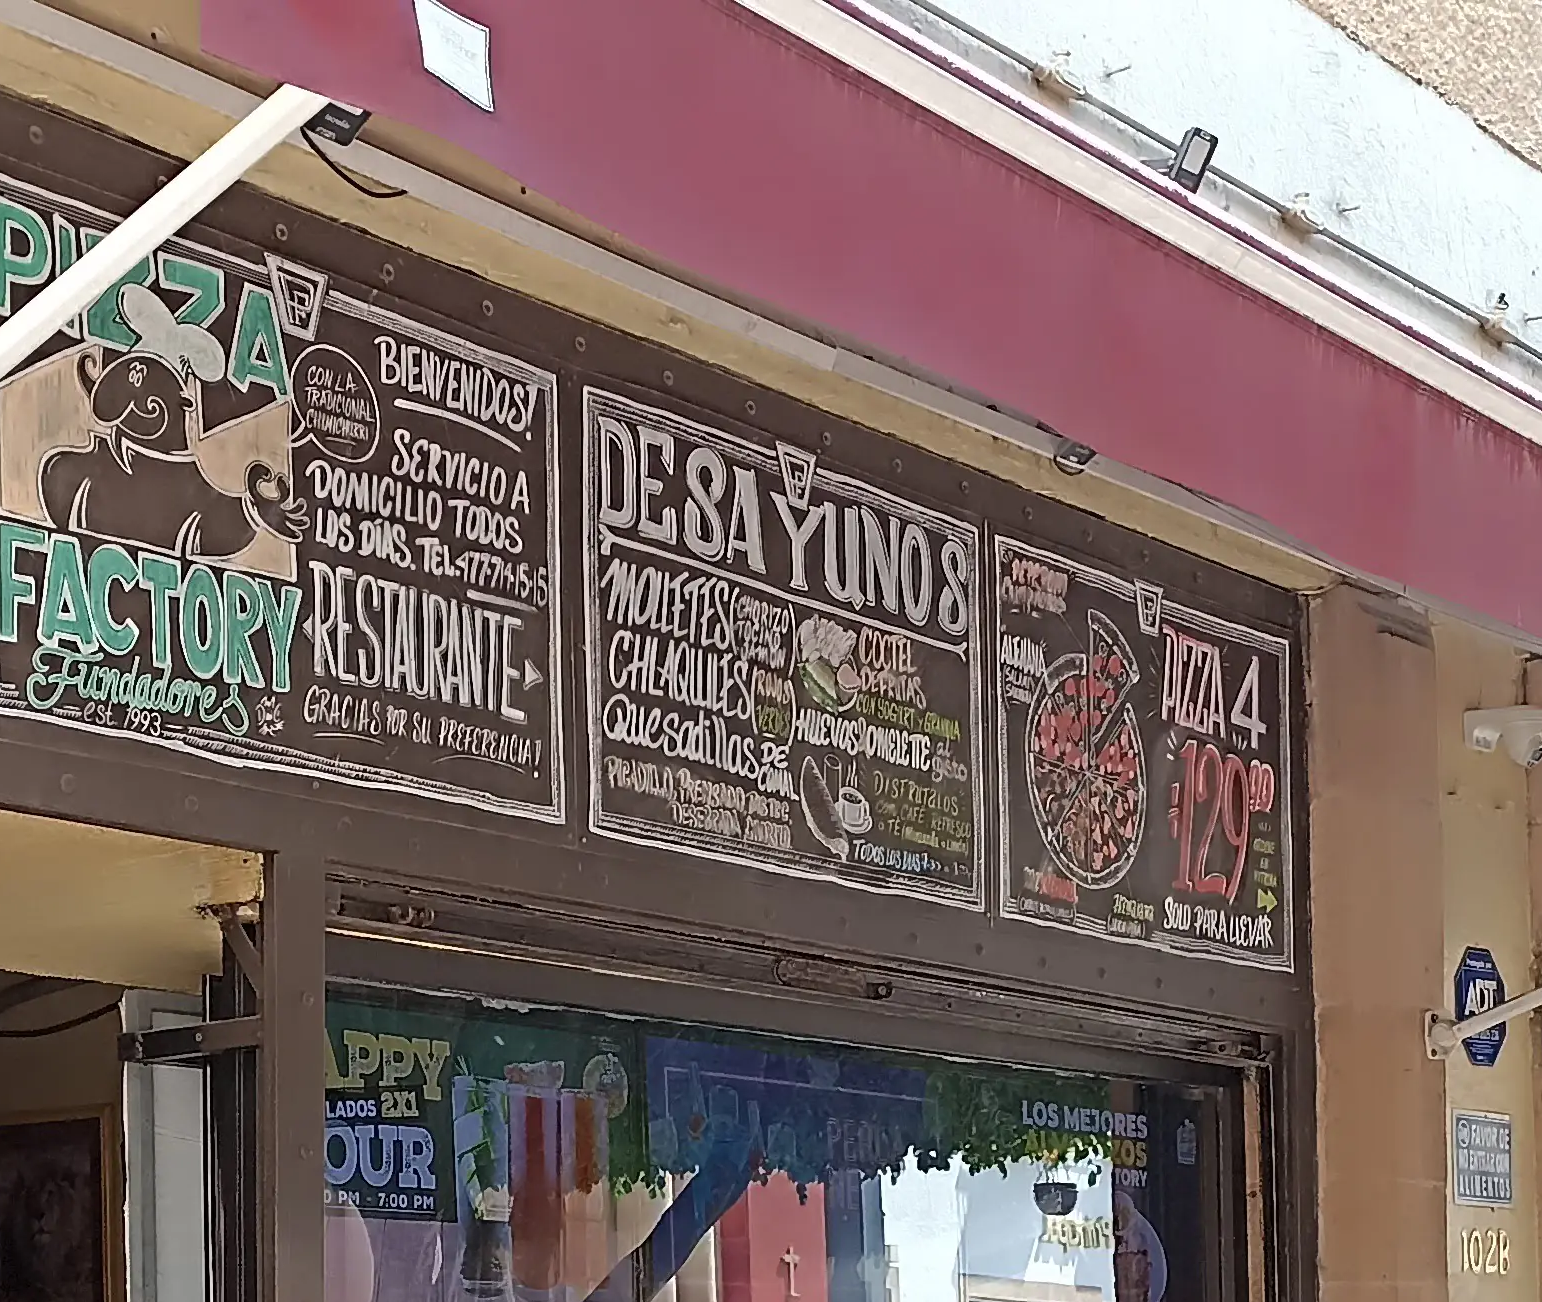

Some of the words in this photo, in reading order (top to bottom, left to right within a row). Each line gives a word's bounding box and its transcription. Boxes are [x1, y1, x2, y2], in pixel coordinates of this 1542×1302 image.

[307, 365, 335, 391] CON
[335, 371, 360, 395] LA
[373, 335, 541, 441] BIENVENIDOS!
[304, 386, 376, 425] TRADICIONAL
[391, 427, 507, 506] SERVICIO
[510, 470, 531, 515] A
[305, 459, 443, 532] DOMICILIO
[448, 498, 524, 555] TODOS
[315, 506, 356, 553] LOS
[597, 415, 970, 637] DESAYUNOS
[600, 557, 731, 651] MOLLETES
[309, 560, 528, 725] RESTAURANTE
[859, 625, 918, 674] COCTEL
[26, 644, 250, 737] Fundadores
[1161, 623, 1227, 741] PIZZA
[122, 708, 162, 738] 1993
[303, 684, 383, 736] GRACIAS
[386, 704, 409, 739] POR
[412, 711, 434, 745] SU
[438, 715, 542, 780] PREFERENCIA!
[602, 693, 760, 781] Quesadillas
[760, 741, 790, 769] DE
[796, 707, 860, 757] HUEVOS
[853, 839, 885, 867] TODOS
[1193, 904, 1228, 944] PARA
[1229, 913, 1275, 949] LLEVAR
[1464, 978, 1498, 1017] ADT
[1022, 1099, 1059, 1129] LOS
[1063, 1104, 1148, 1139] MEJORES
[1471, 1124, 1498, 1149] FAVOR
[324, 1123, 437, 1190] OUR
[1115, 1169, 1148, 1188] TORY
[377, 1192, 408, 1209] 7:00
[413, 1194, 435, 1211] PM
[1459, 1174, 1511, 1199] ALIMENTOS
[1461, 1228, 1510, 1276] 102B
